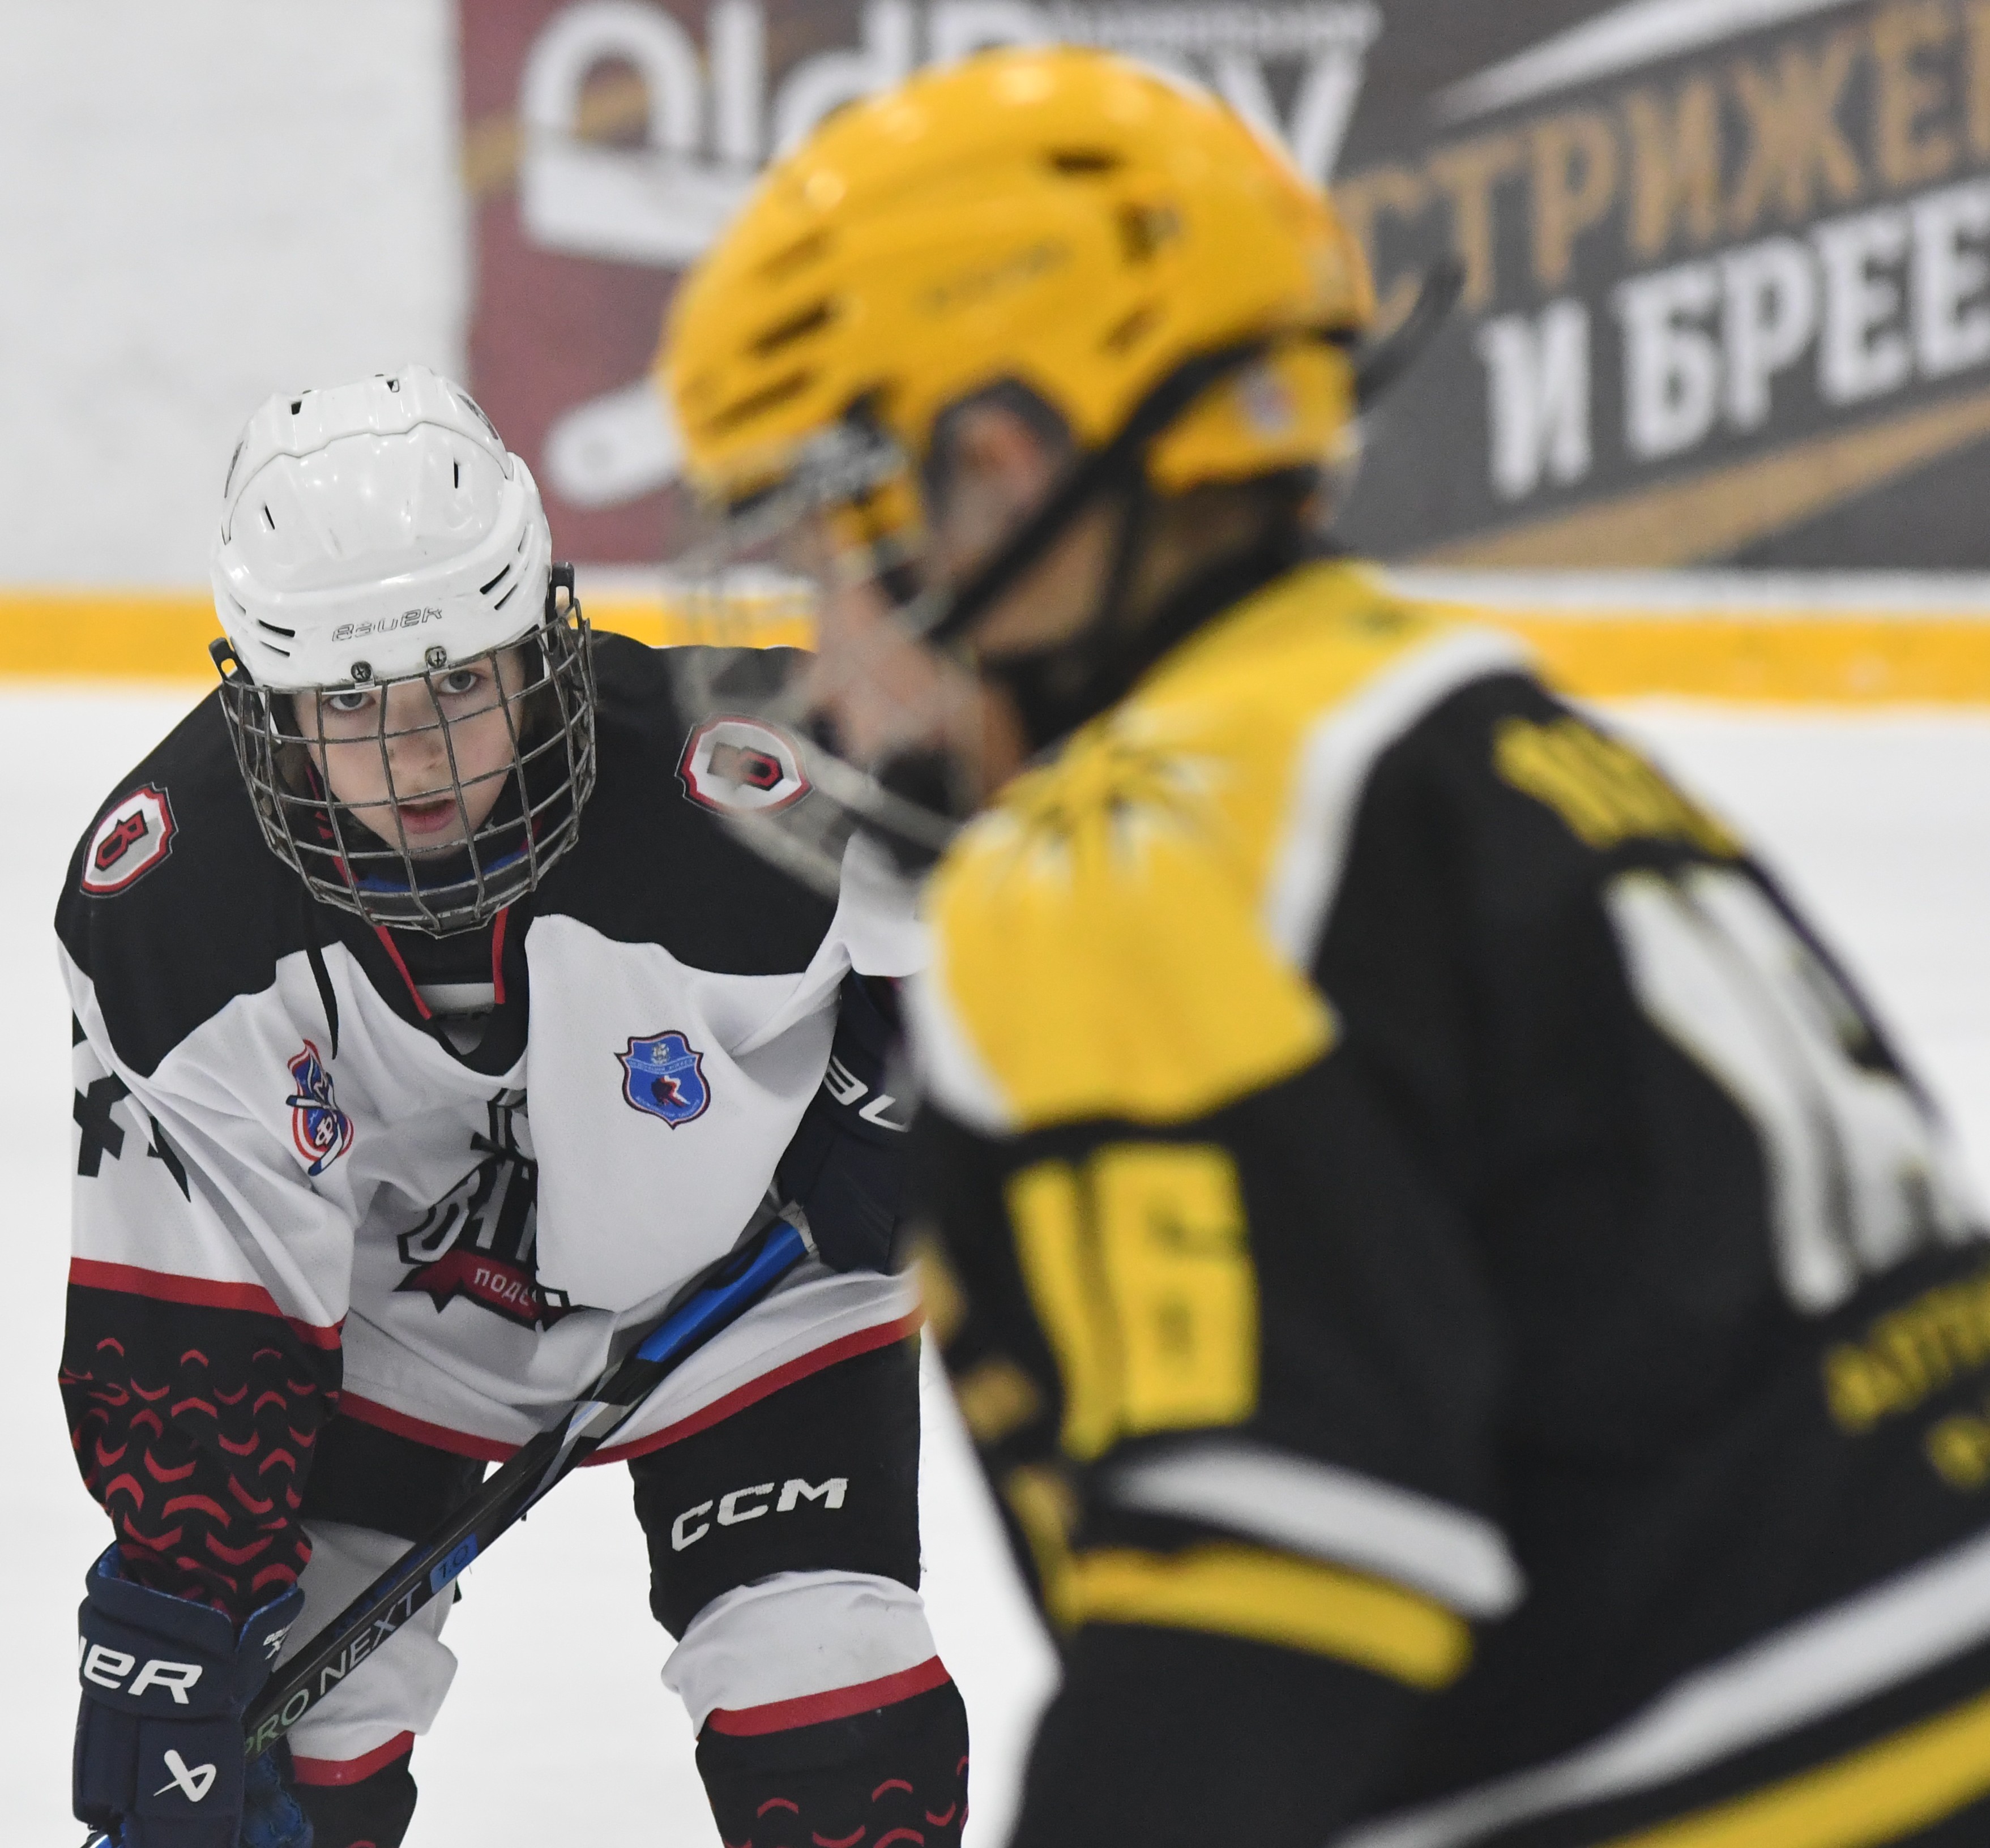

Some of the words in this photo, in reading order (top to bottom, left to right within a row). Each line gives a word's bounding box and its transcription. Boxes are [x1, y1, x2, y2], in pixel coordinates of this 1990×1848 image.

[1477, 297, 1591, 502] И
[1005, 1141, 1261, 1464] 16
[672, 1478, 848, 1551] CCM
[321, 1581, 421, 1696] NEXT
